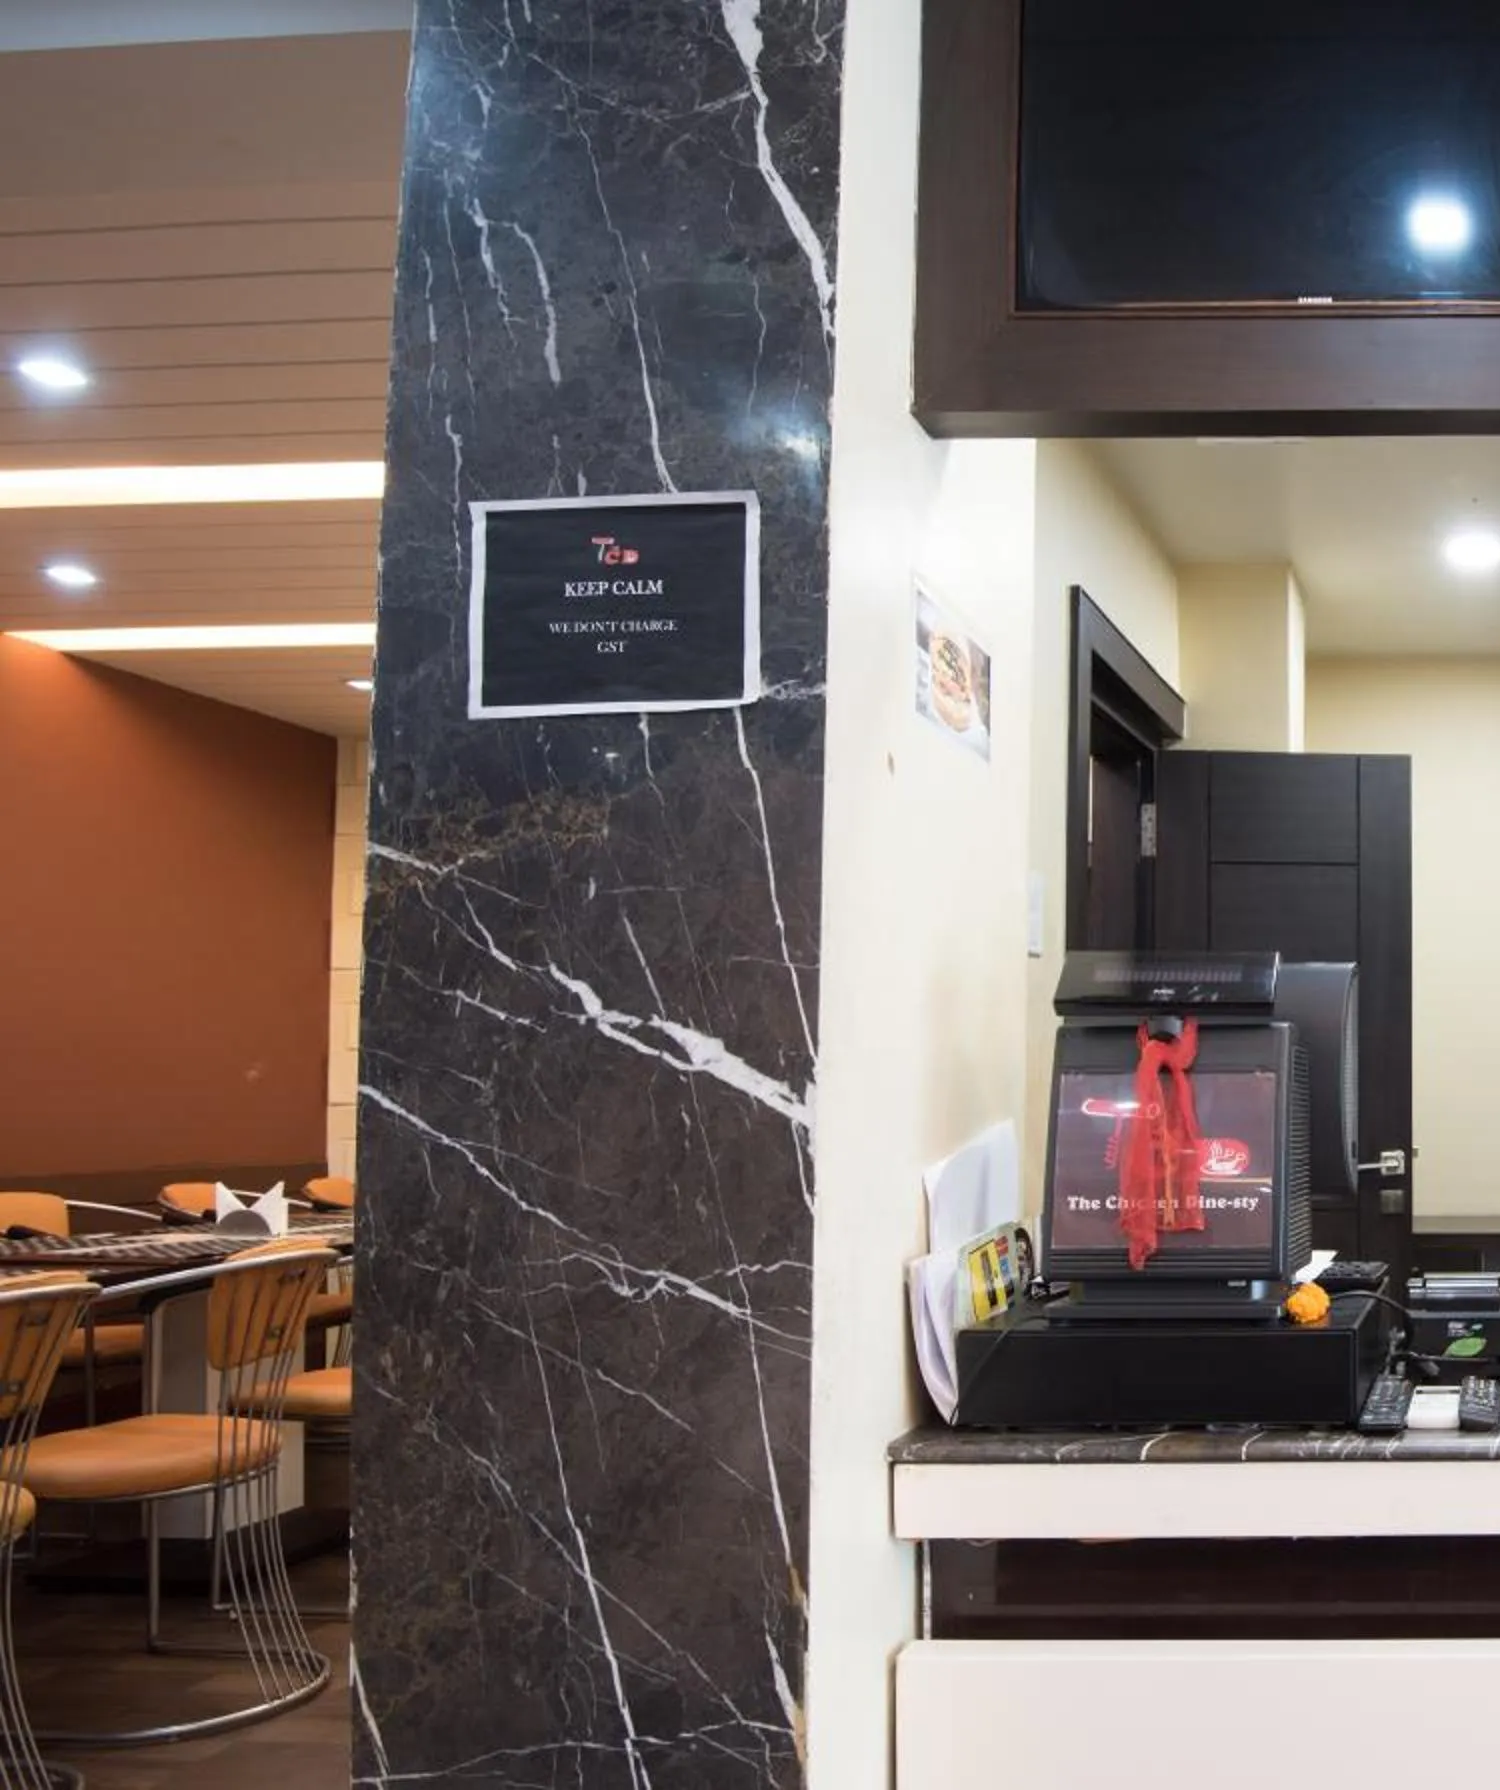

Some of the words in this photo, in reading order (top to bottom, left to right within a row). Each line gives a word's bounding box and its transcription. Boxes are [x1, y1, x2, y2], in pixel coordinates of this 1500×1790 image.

[565, 581, 609, 597] KEEP
[612, 580, 663, 595] CALM
[549, 623, 571, 633] WE
[620, 620, 678, 632] CHARGE
[597, 641, 626, 653] GST
[1067, 1196, 1100, 1210] The
[1105, 1195, 1179, 1209] Chicen
[1186, 1195, 1259, 1211] Dine-sty
